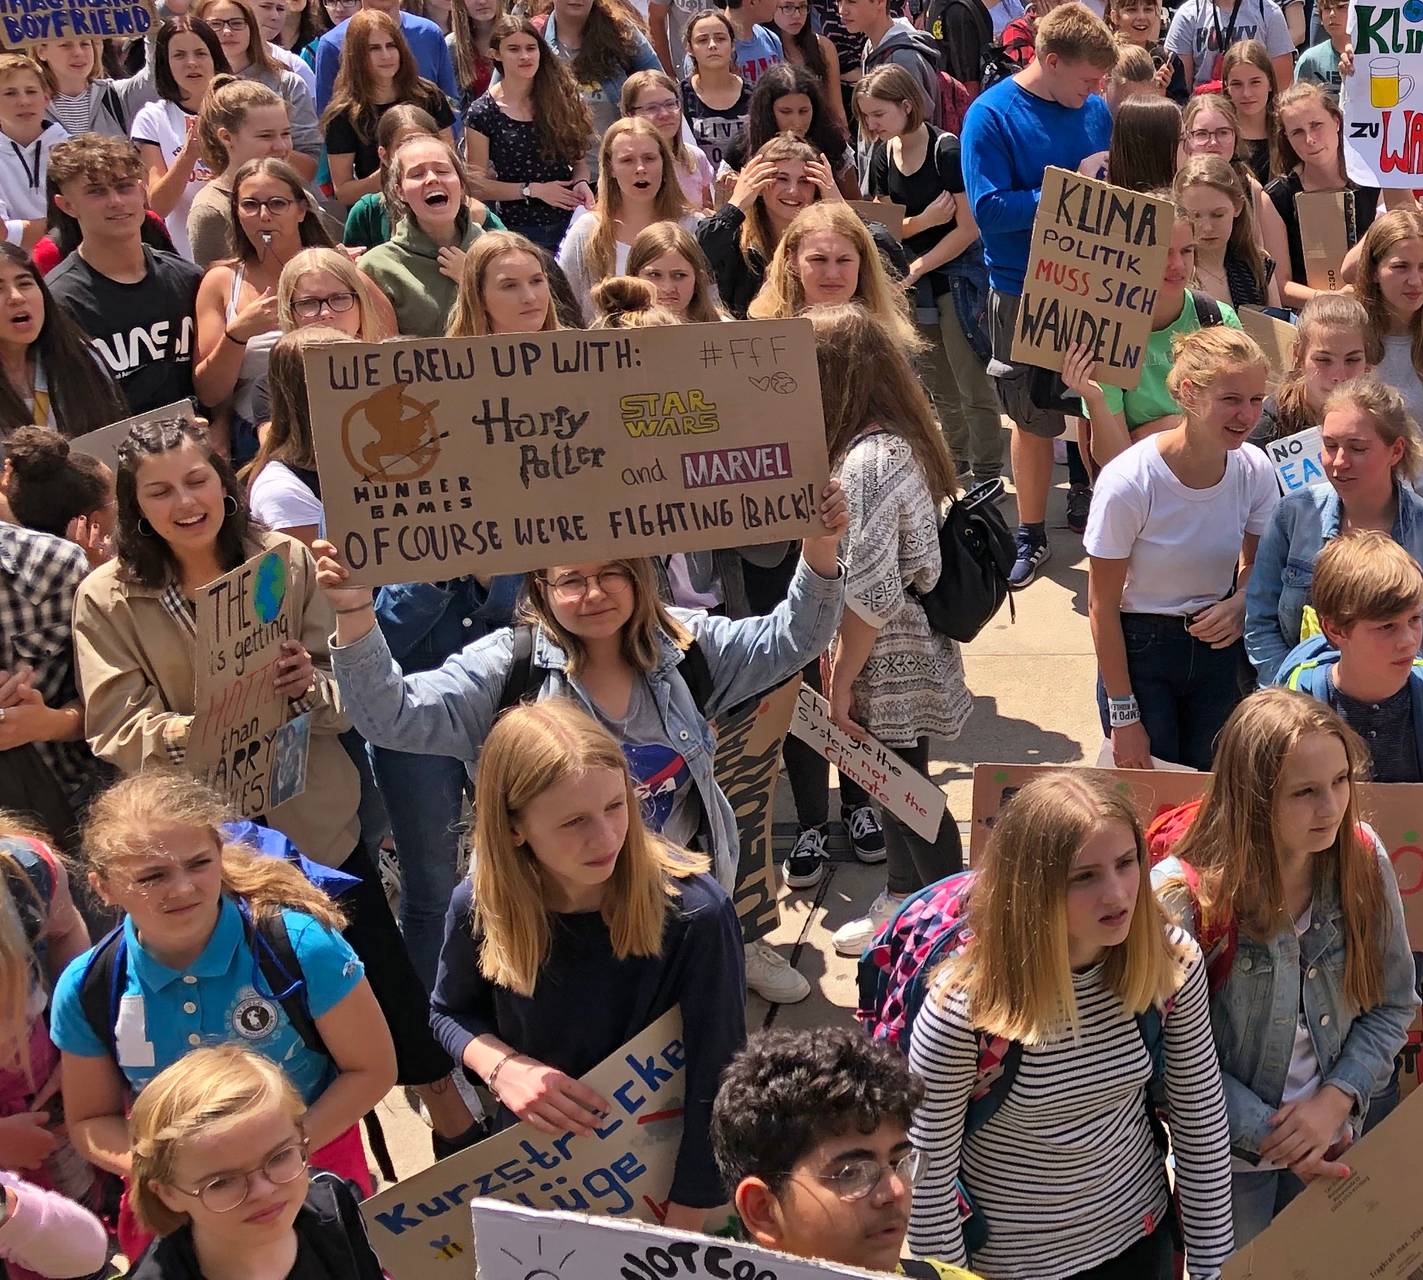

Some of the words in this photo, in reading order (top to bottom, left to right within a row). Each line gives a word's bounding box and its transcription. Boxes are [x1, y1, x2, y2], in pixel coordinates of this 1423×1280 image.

[3, 5, 151, 44] BOYFRIEND
[1055, 178, 1158, 246] KLIMA
[1042, 228, 1142, 276] POLITIK
[1034, 258, 1091, 297] MUSS
[1095, 277, 1158, 316] SICH
[1020, 292, 1142, 370] WANDELN
[328, 353, 382, 391] WE
[392, 347, 476, 385] GREW
[490, 342, 542, 378] UP
[551, 337, 642, 374] WITH:
[472, 397, 590, 444] Harry
[619, 389, 717, 420] STAR
[622, 412, 721, 438] WARS
[520, 442, 606, 490] Potter
[621, 457, 668, 487] and
[683, 447, 790, 487] MARVEL
[1272, 440, 1303, 463] NO
[344, 526, 391, 570] OF
[397, 519, 503, 562] COURSE
[513, 514, 588, 546] WE'RE
[608, 498, 734, 539] FIGHTING
[370, 497, 473, 520] GAMES
[208, 569, 251, 643] THE
[210, 650, 226, 676] is
[234, 613, 288, 676] getting
[221, 716, 259, 755] than
[799, 688, 872, 756] Chge
[876, 748, 902, 777] the
[204, 729, 277, 798] ARRY
[798, 706, 854, 759] System
[861, 760, 888, 785] not
[904, 791, 928, 818] the
[824, 746, 890, 804] Climate
[498, 1151, 648, 1216] üge
